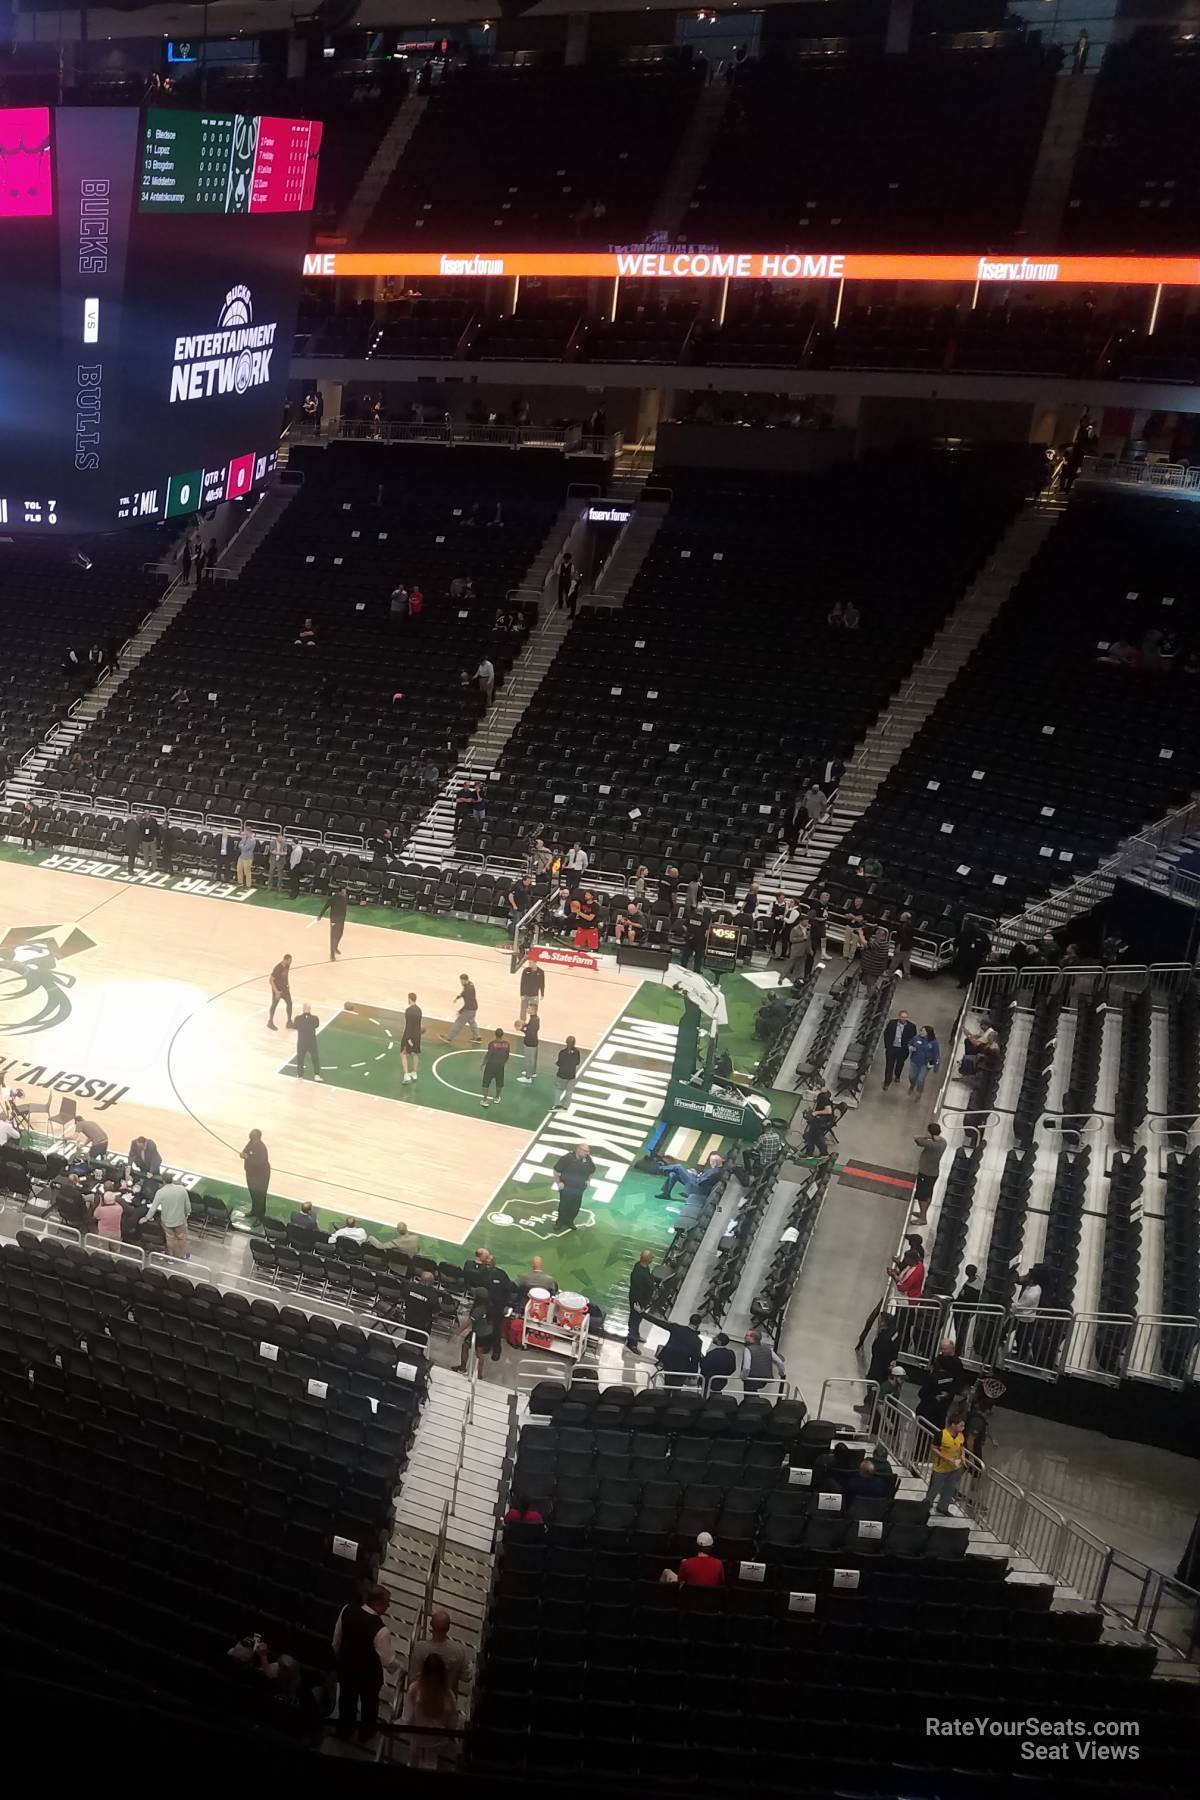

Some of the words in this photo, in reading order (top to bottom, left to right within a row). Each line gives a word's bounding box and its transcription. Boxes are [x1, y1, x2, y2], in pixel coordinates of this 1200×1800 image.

[79, 179, 110, 274] BUCKS
[616, 254, 752, 276] WELCOME
[761, 255, 845, 277] HOME
[226, 284, 252, 306] BUCKS
[174, 323, 277, 360] ENTERTAINMENT
[170, 348, 273, 403] NETWORK
[74, 364, 102, 470] BULLS
[204, 471, 218, 487] QTR
[220, 468, 226, 481] 1
[237, 468, 245, 487] 0
[140, 490, 159, 515] MIL
[180, 484, 190, 505] 0
[48, 501, 56, 511] 7
[49, 514, 56, 524] 0
[39, 854, 115, 878] DEER
[170, 880, 258, 901] FEAR
